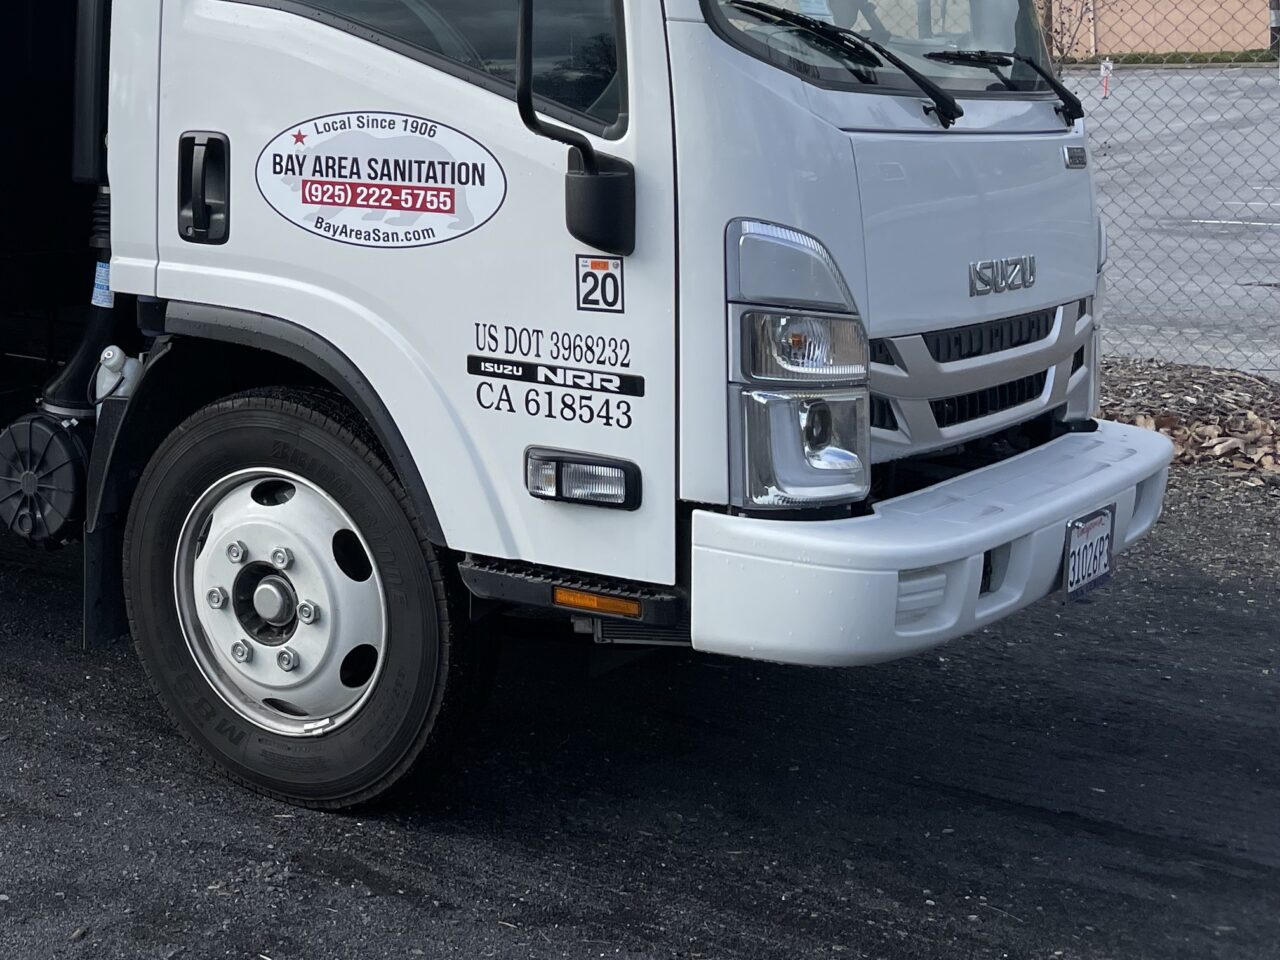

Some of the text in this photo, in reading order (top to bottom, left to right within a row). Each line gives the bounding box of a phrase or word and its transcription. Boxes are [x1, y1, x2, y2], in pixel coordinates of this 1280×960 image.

[314, 115, 438, 139] Local Since 1906
[272, 153, 485, 187] BAY AREA SANITATION
[304, 182, 452, 210] (925) 222-5755
[314, 216, 436, 243] BayAreaSan.com
[581, 271, 619, 307] 20
[969, 255, 1036, 297] ISUZU
[475, 322, 631, 368] US DOT 3968232
[480, 362, 621, 392] ISUZU NRR
[476, 381, 632, 429] CA 618543
